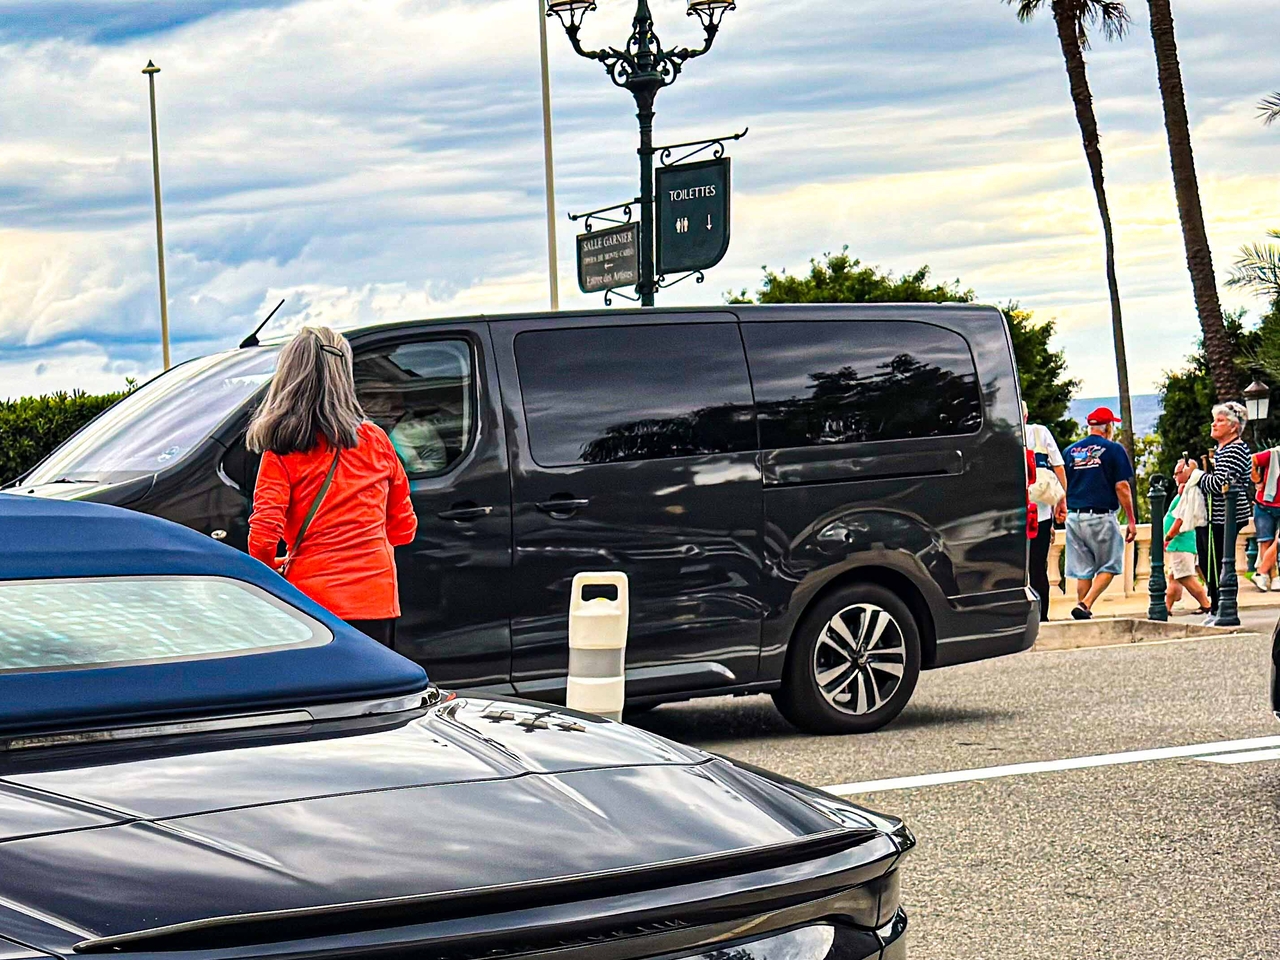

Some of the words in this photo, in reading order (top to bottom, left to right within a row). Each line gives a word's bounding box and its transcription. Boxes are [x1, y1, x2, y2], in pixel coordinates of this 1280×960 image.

[669, 184, 716, 202] TOILETTES
[583, 237, 602, 252] SALLE
[603, 231, 633, 247] GARNIER
